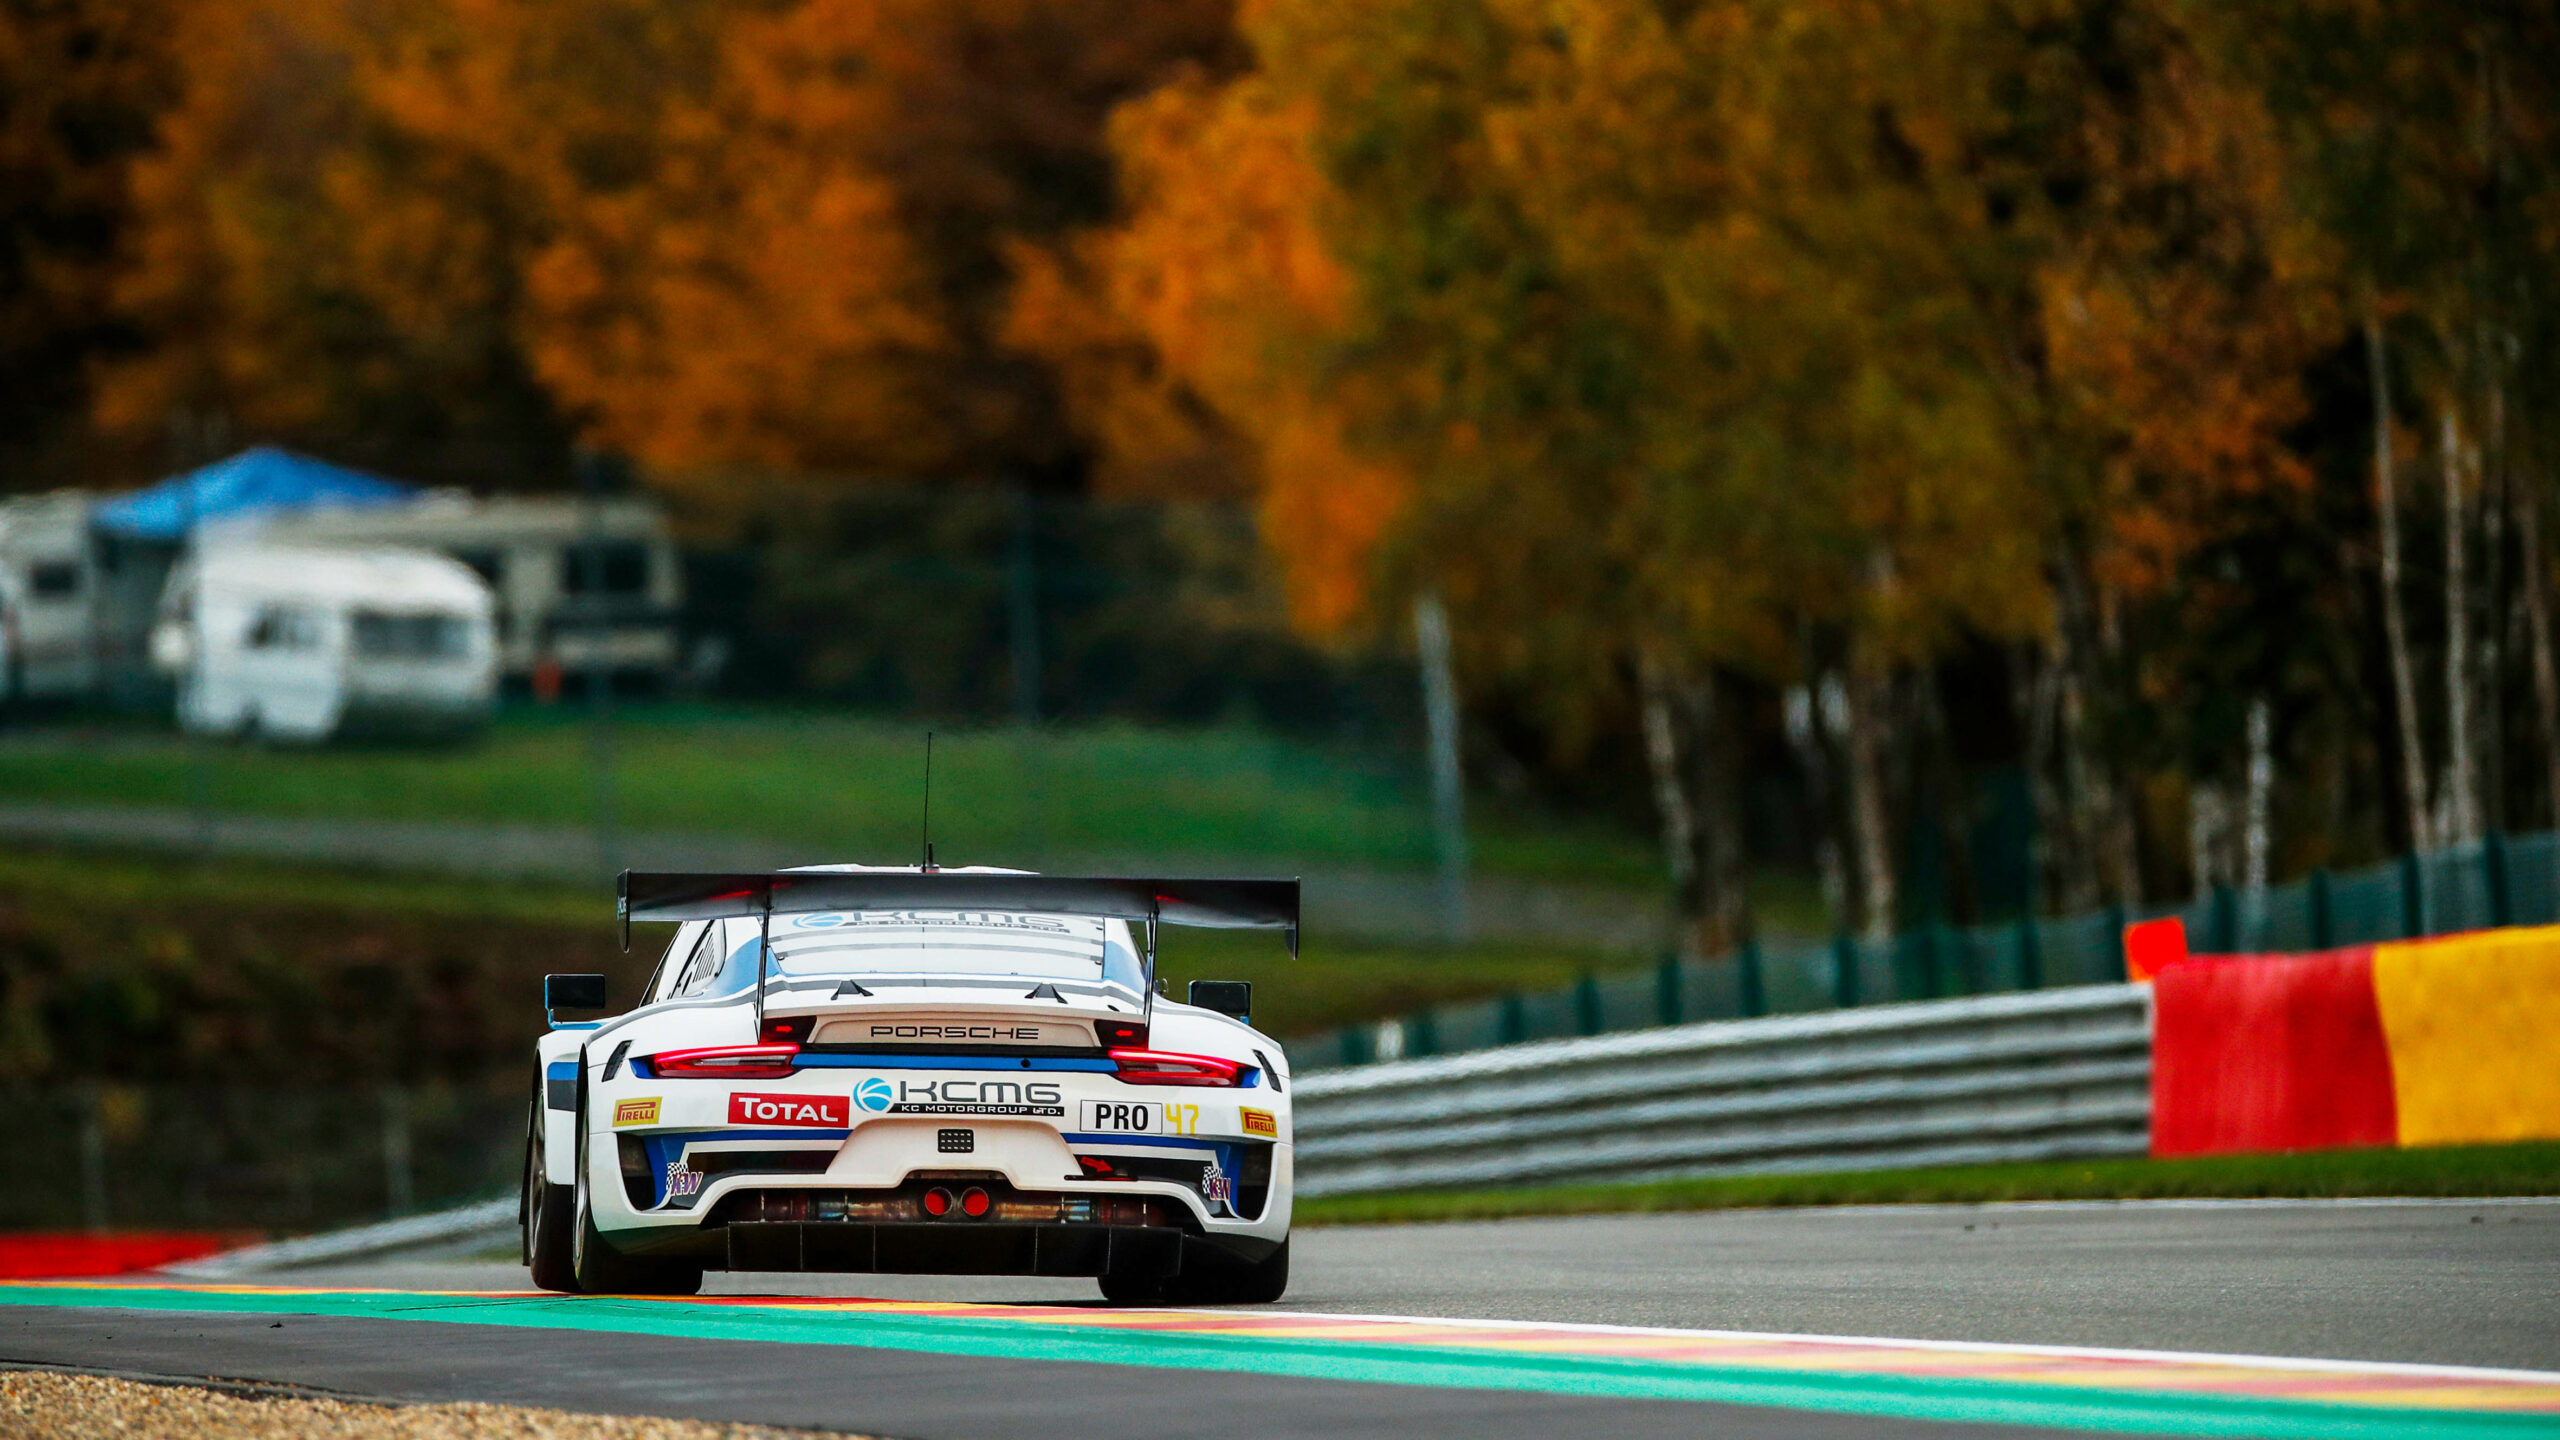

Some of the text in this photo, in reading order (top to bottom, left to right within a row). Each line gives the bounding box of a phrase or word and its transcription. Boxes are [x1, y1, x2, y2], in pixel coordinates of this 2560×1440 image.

[871, 1026, 1039, 1039] PORSCHE
[900, 1081, 1061, 1104] KCMG
[617, 1101, 656, 1122] PIRELLI
[738, 1097, 839, 1122] TOTAL
[901, 1104, 1061, 1115] KC MOTORGROUP LTD.
[1095, 1103, 1149, 1131] PRO
[1166, 1103, 1199, 1135] 47
[1245, 1112, 1275, 1133] PIRELLI
[670, 1172, 704, 1196] KW
